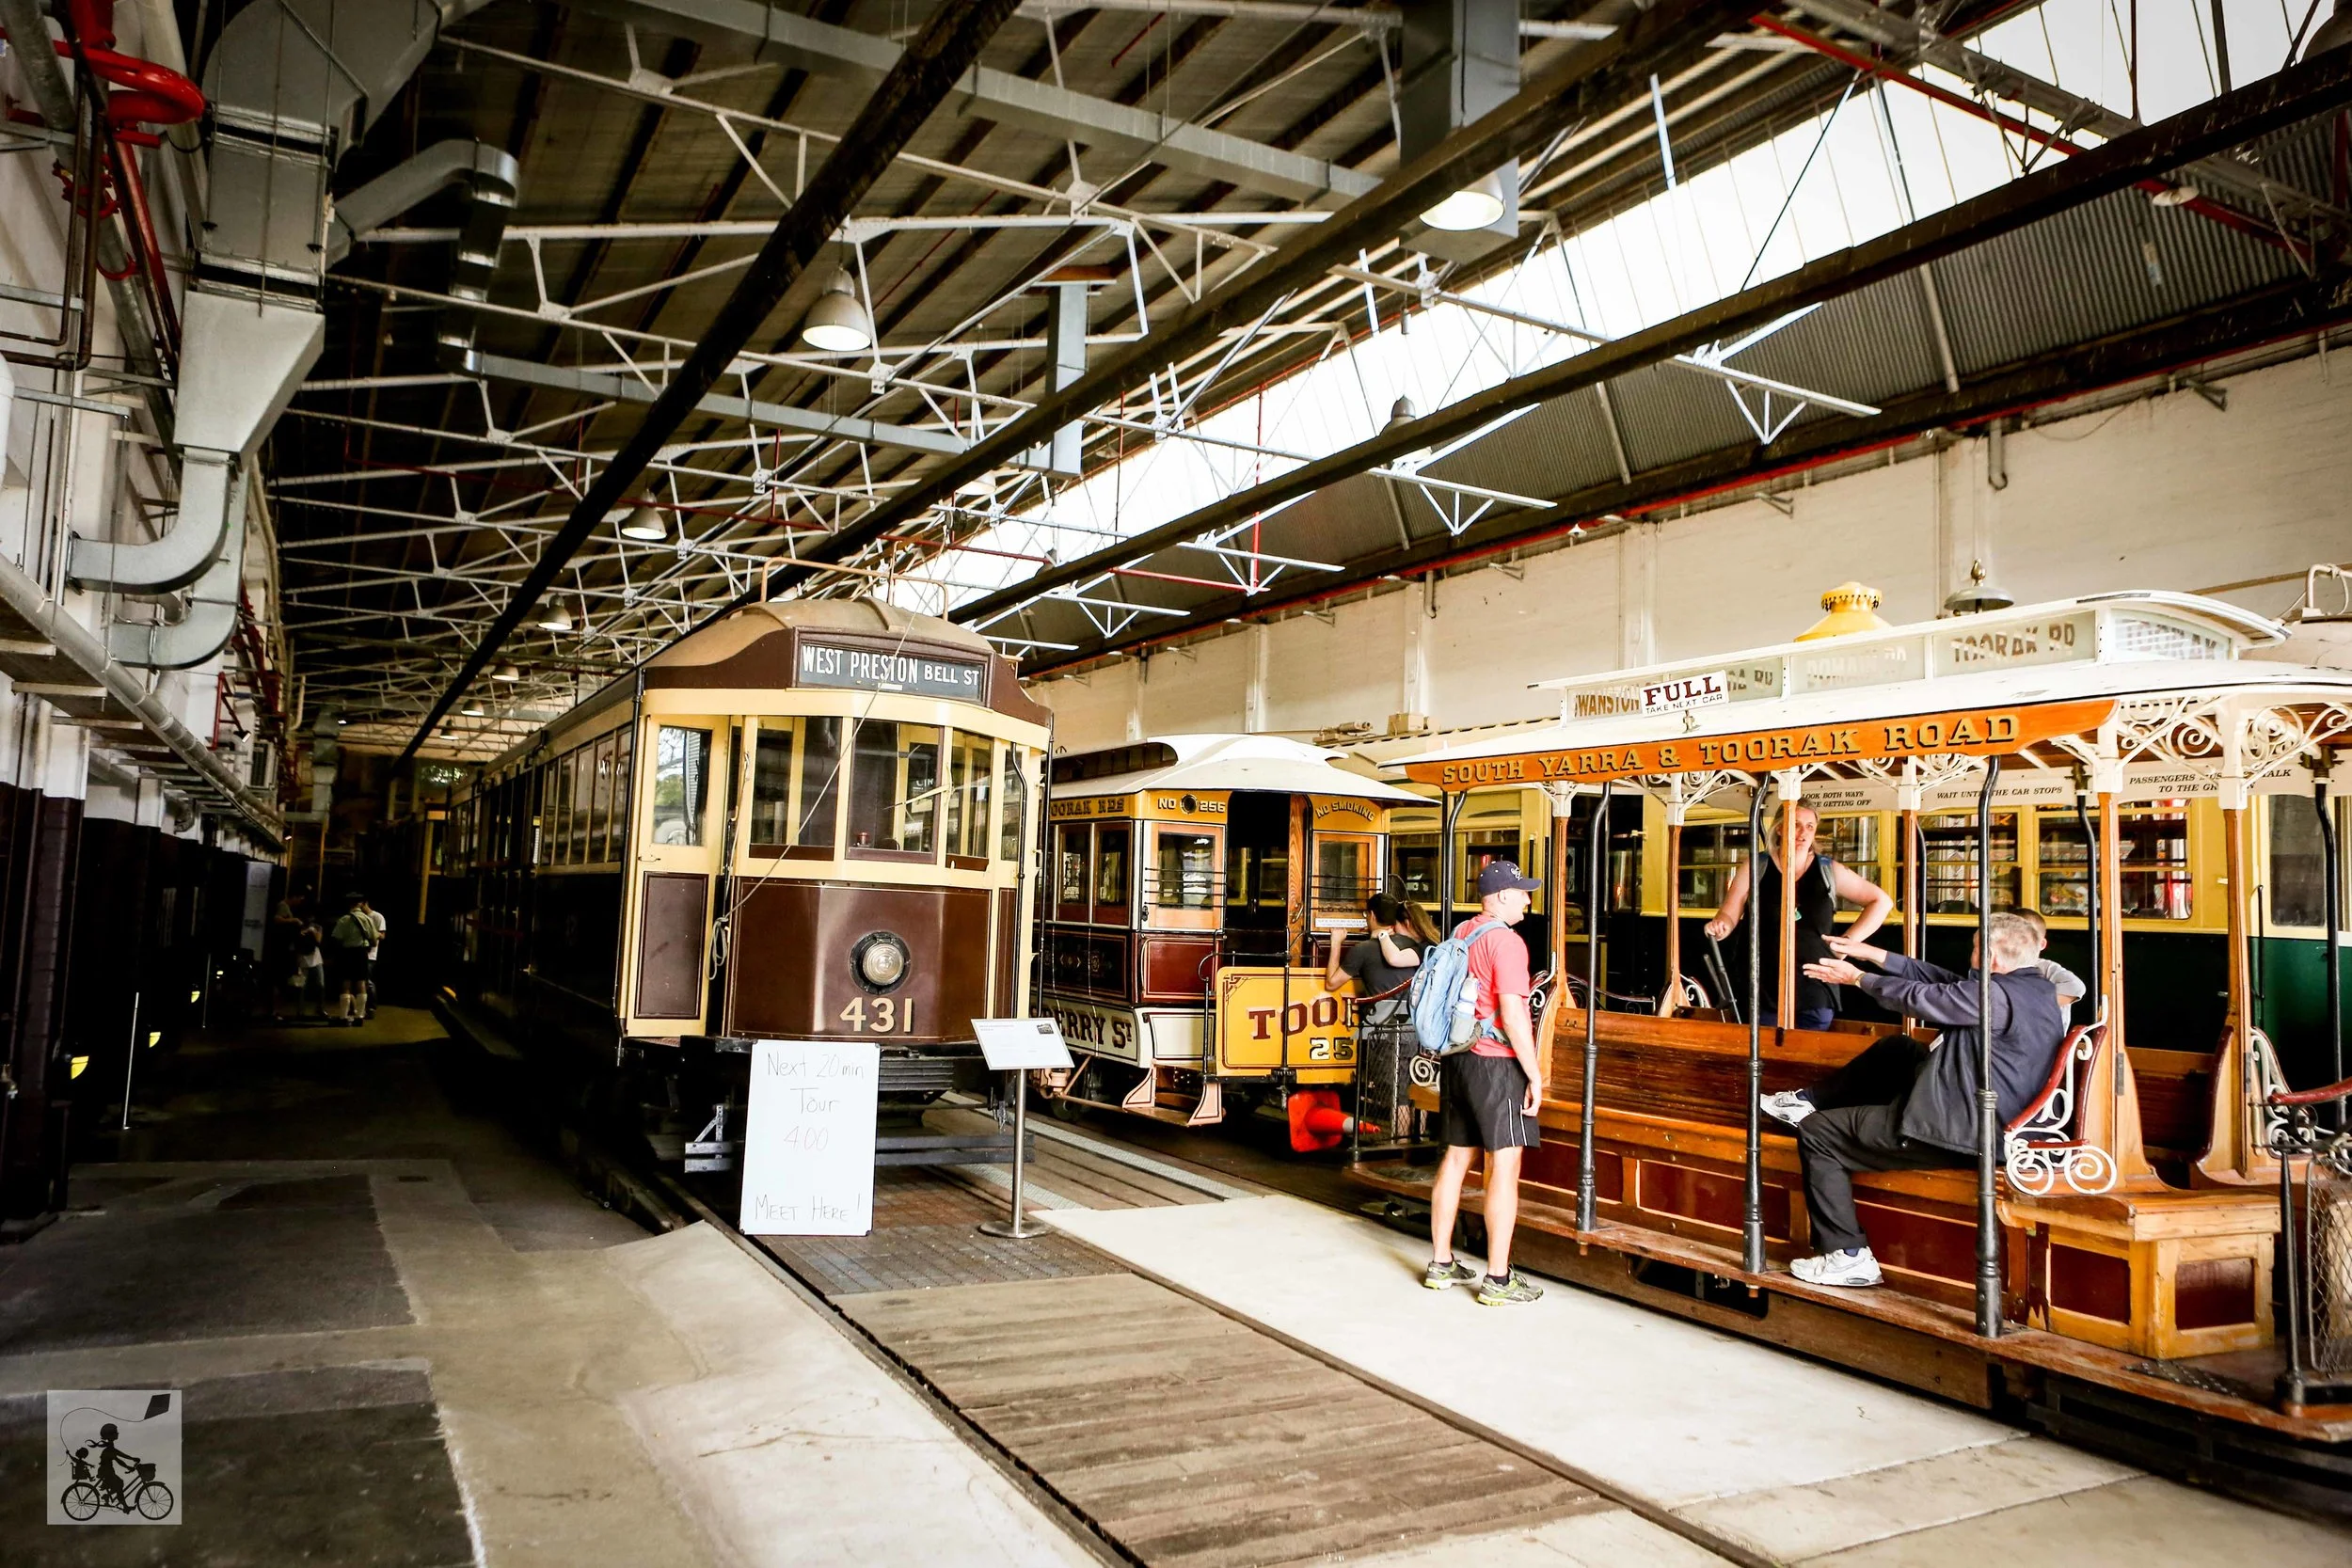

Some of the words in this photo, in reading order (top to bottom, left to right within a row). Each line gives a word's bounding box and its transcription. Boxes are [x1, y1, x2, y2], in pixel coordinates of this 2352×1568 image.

[803, 645, 844, 675] WEST
[850, 651, 918, 684] PRESTON
[924, 663, 958, 684] BELL
[963, 670, 979, 686] ST
[1644, 675, 1722, 705] FULL
[1645, 704, 1669, 714] TAKE
[1673, 698, 1696, 710] NEXT
[1702, 693, 1723, 705] CAR
[1442, 759, 1524, 784] SOUTH
[1538, 749, 1645, 777] YARRA
[1659, 745, 1681, 768] &
[1699, 728, 1862, 765] TOORAK
[1884, 714, 2021, 751] ROAD
[2129, 773, 2195, 784] PASSENGERS
[2177, 784, 2199, 792] THE
[1157, 798, 1176, 810] NO
[1199, 800, 1226, 813] 256
[1961, 790, 1982, 799] UNTI
[2034, 786, 2063, 795] STOPS
[1315, 805, 1329, 819] NO
[1331, 800, 1375, 822] SMOKING
[839, 997, 913, 1033] 431
[768, 1051, 807, 1077] Next
[790, 1087, 840, 1114] Tour
[755, 1194, 798, 1221] MEET
